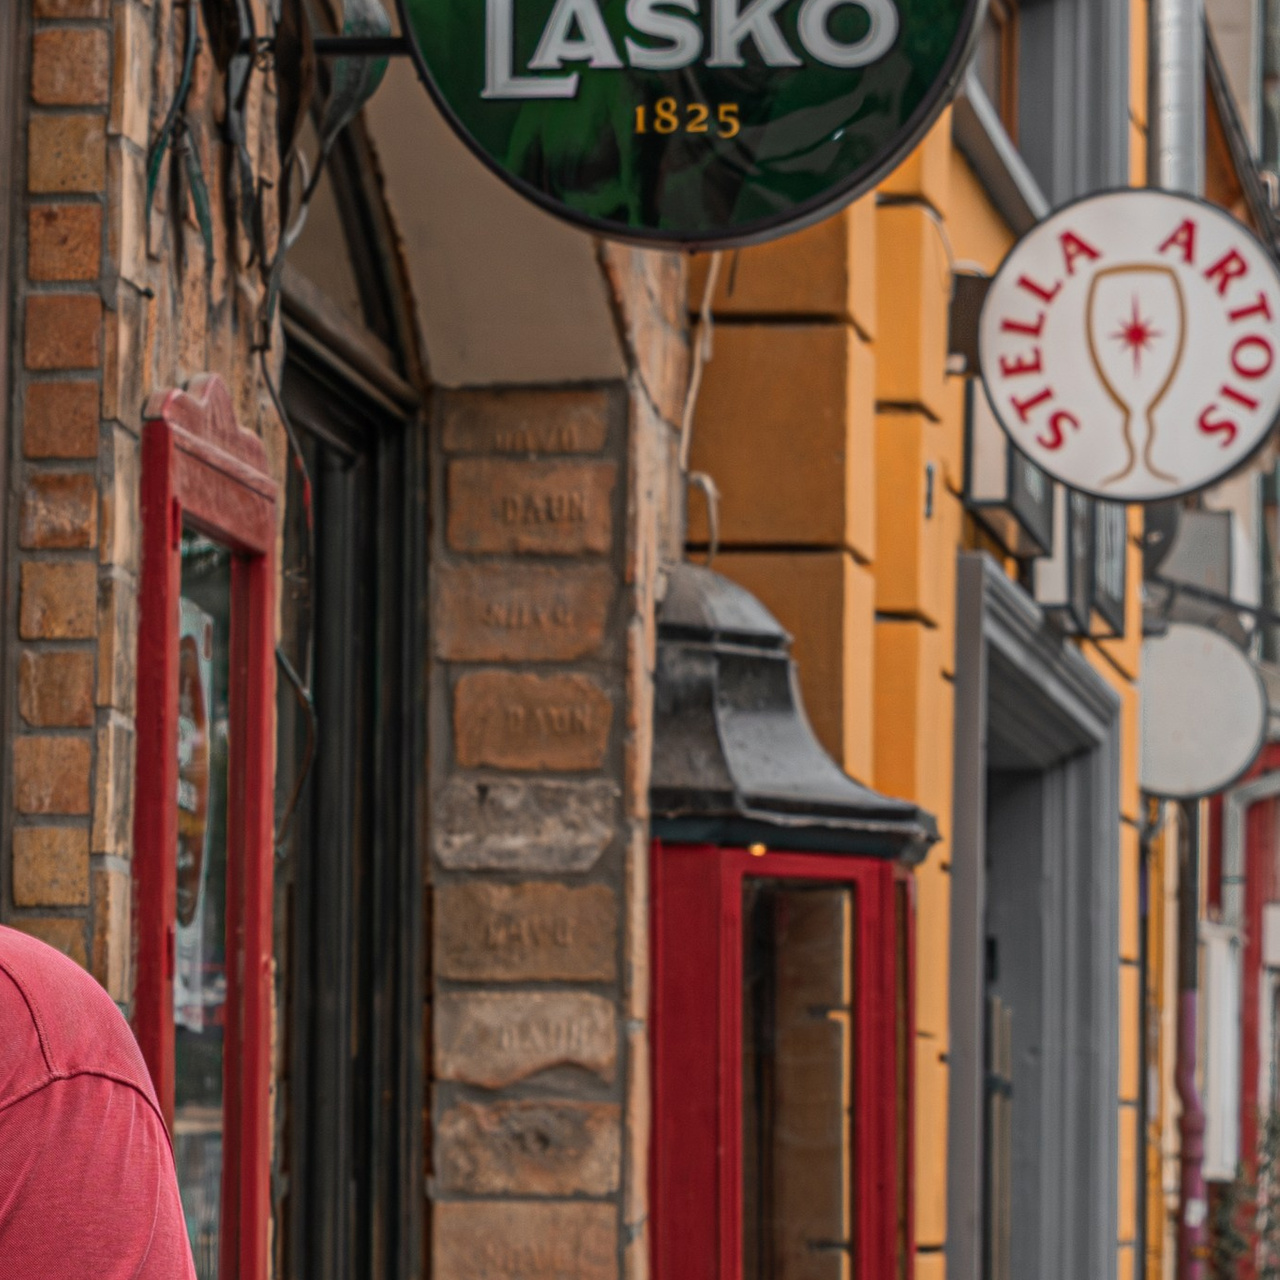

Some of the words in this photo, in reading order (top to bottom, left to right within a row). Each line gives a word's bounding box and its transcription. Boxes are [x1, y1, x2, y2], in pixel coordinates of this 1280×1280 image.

[634, 97, 741, 138] 1825
[999, 230, 1102, 451] STELLA
[1157, 218, 1275, 448] ARTOIS
